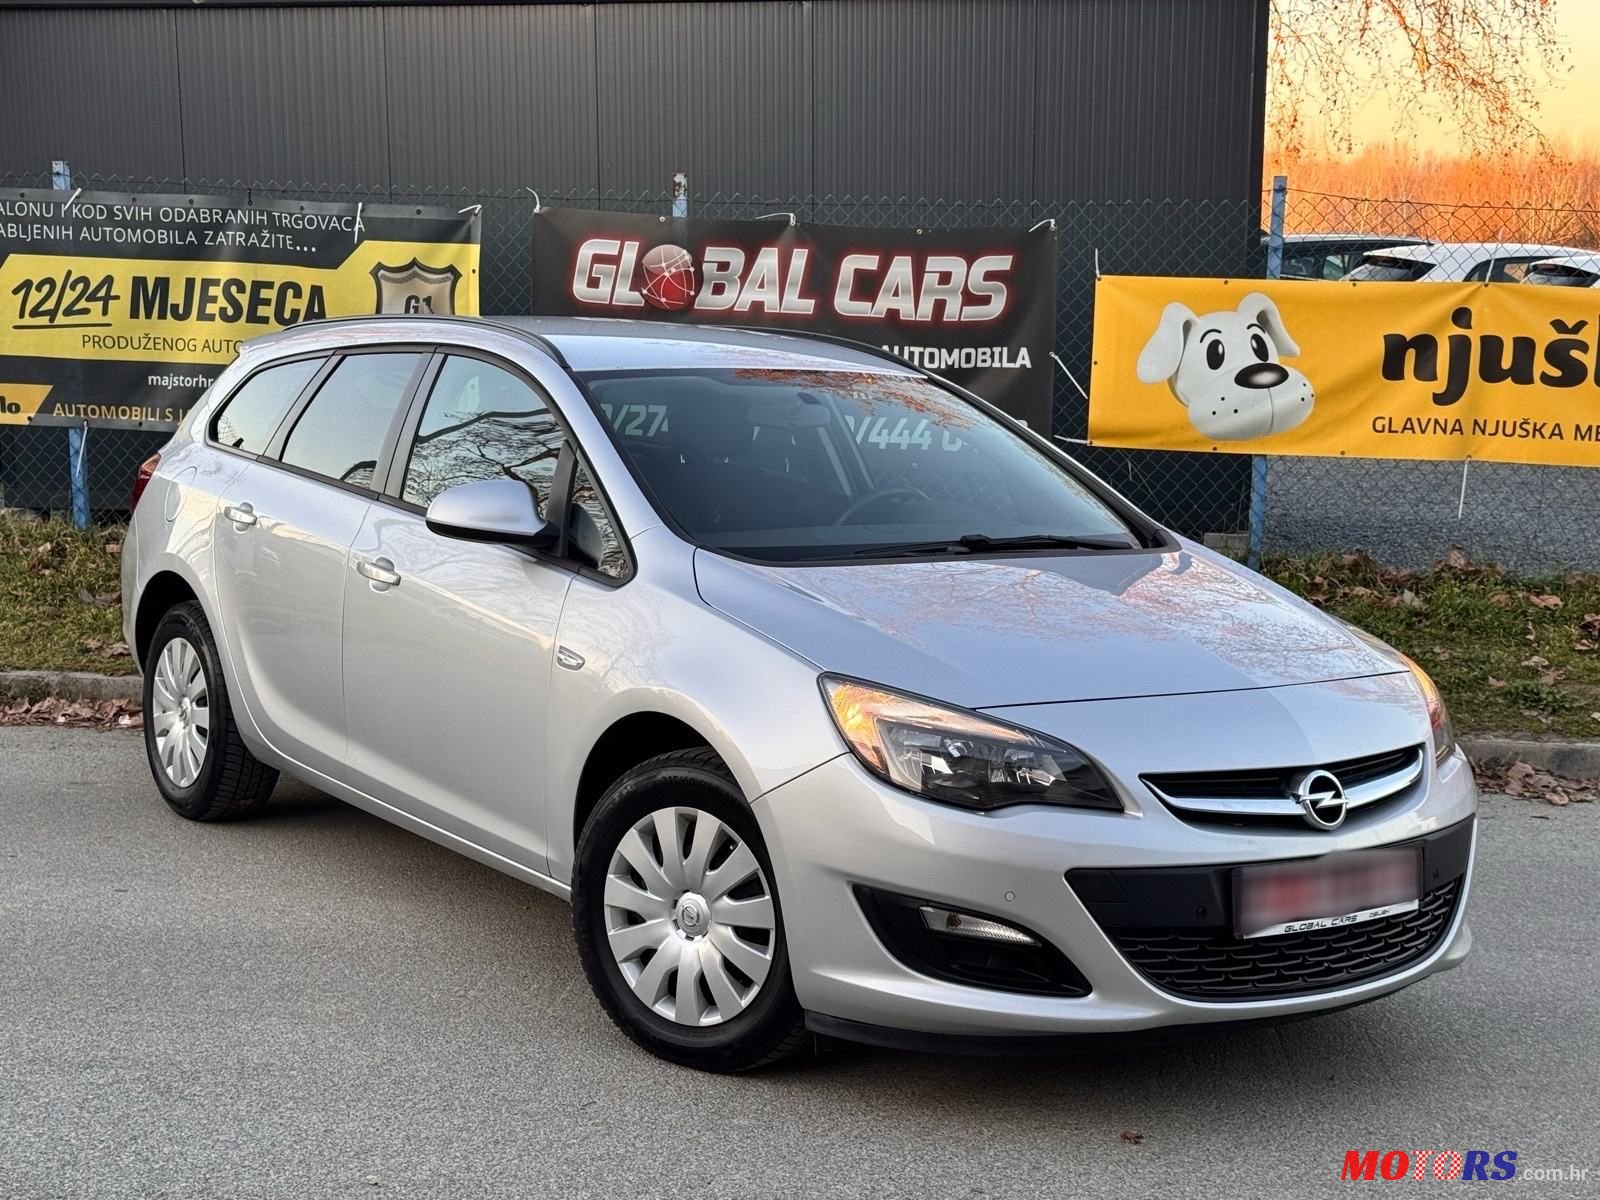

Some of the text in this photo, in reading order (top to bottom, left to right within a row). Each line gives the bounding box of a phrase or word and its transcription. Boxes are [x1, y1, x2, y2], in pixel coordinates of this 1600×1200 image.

[61, 203, 66, 218] I
[72, 204, 107, 220] KOD
[113, 205, 152, 221] SVIH
[159, 207, 267, 225] ODABRANIH
[272, 212, 365, 232] TRGOVACA
[80, 226, 198, 246] AUTOMOBILA
[11, 269, 327, 327] 12/24 MJESECA
[834, 254, 1014, 322] CARS
[82, 333, 197, 352] PRODUŽENOG
[1381, 306, 1600, 407] njuš
[53, 402, 160, 422] AUTOMOBILI
[164, 407, 174, 422] S
[1372, 416, 1464, 435] GLAVNA
[1472, 418, 1564, 440] NJUŠKA
[1284, 914, 1358, 933] GLOBAL CARS
